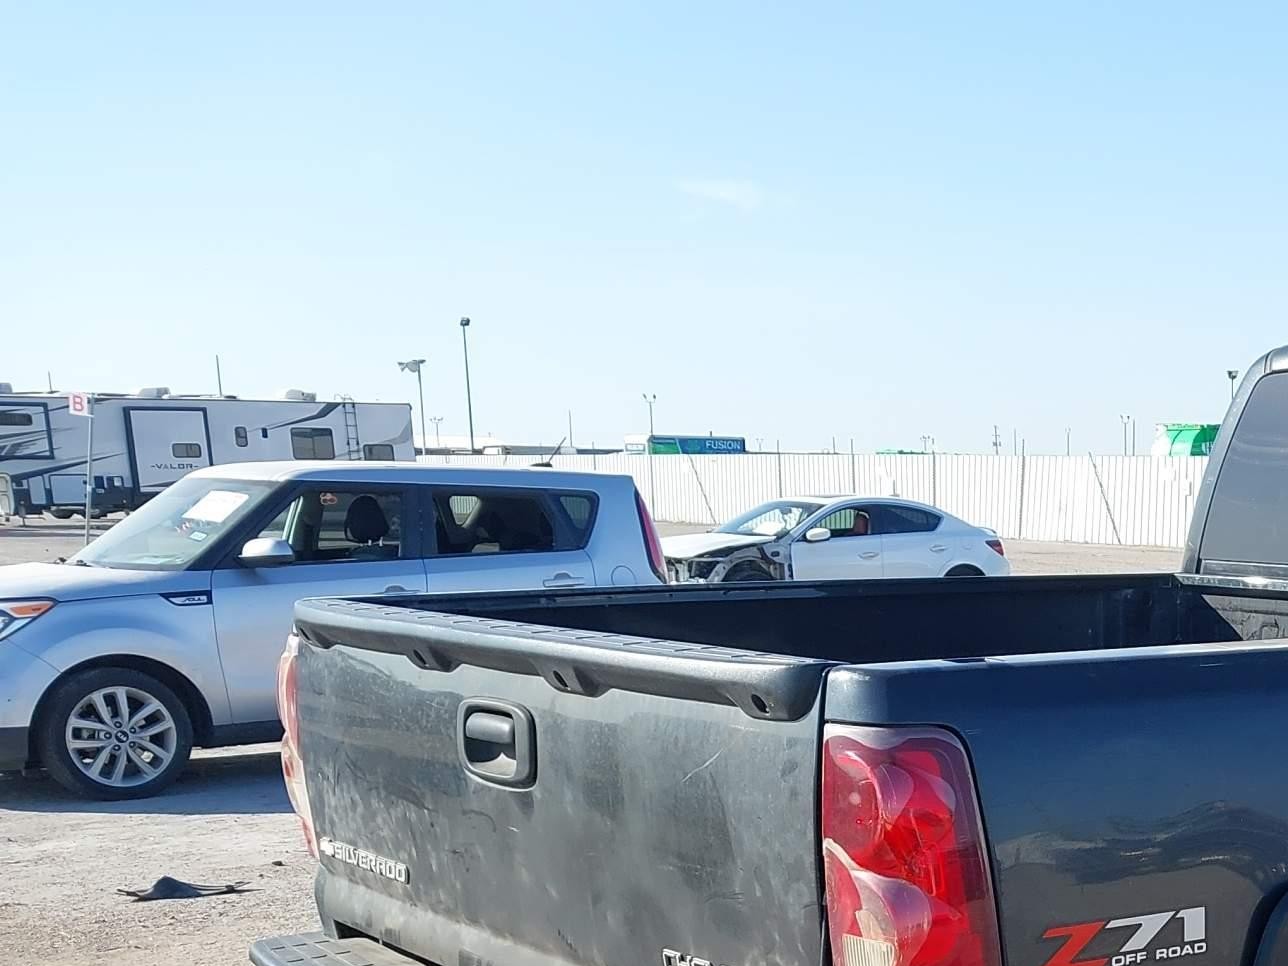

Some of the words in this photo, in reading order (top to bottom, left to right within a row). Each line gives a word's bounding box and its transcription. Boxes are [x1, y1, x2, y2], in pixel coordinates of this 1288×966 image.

[72, 395, 84, 411] B
[705, 440, 741, 450] FUSION
[334, 842, 409, 883] SILVERADO
[1111, 952, 1148, 966] OFF
[1155, 942, 1207, 960] ROAD
